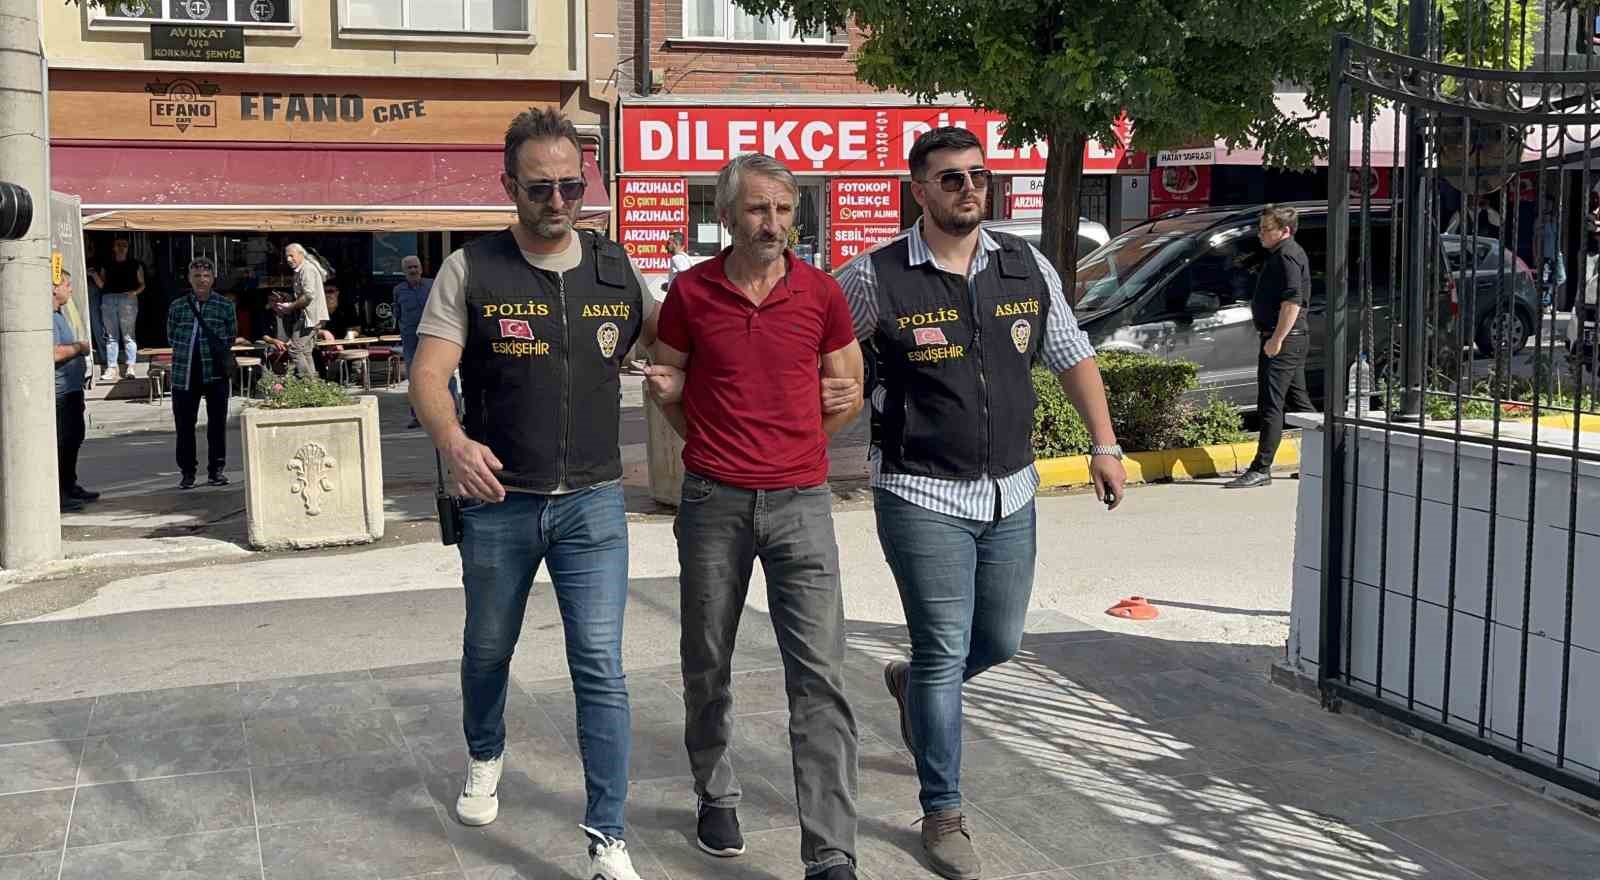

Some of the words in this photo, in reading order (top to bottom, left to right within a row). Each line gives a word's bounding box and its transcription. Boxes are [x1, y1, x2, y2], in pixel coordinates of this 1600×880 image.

[169, 28, 226, 39] AVUKAT
[156, 103, 211, 117] EFANO
[240, 92, 364, 122] EFANO
[373, 100, 426, 124] CAFE
[639, 111, 868, 169] DİLEKÇE
[625, 180, 685, 194] ARZUHALCİ
[837, 181, 891, 193] FOTOKOPİ
[838, 194, 890, 207] DİLEKÇE
[625, 208, 685, 222] ARZUHALCİ
[835, 228, 864, 241] SEBİL
[841, 245, 858, 256] SU
[483, 301, 549, 318] POLİS
[582, 301, 630, 320] ASAYİŞ
[995, 298, 1040, 316] ASAYİŞ
[897, 307, 959, 329] POLİS
[492, 339, 550, 357] ESKİŞEHİR
[907, 343, 965, 363] ESKİŞEHİR
